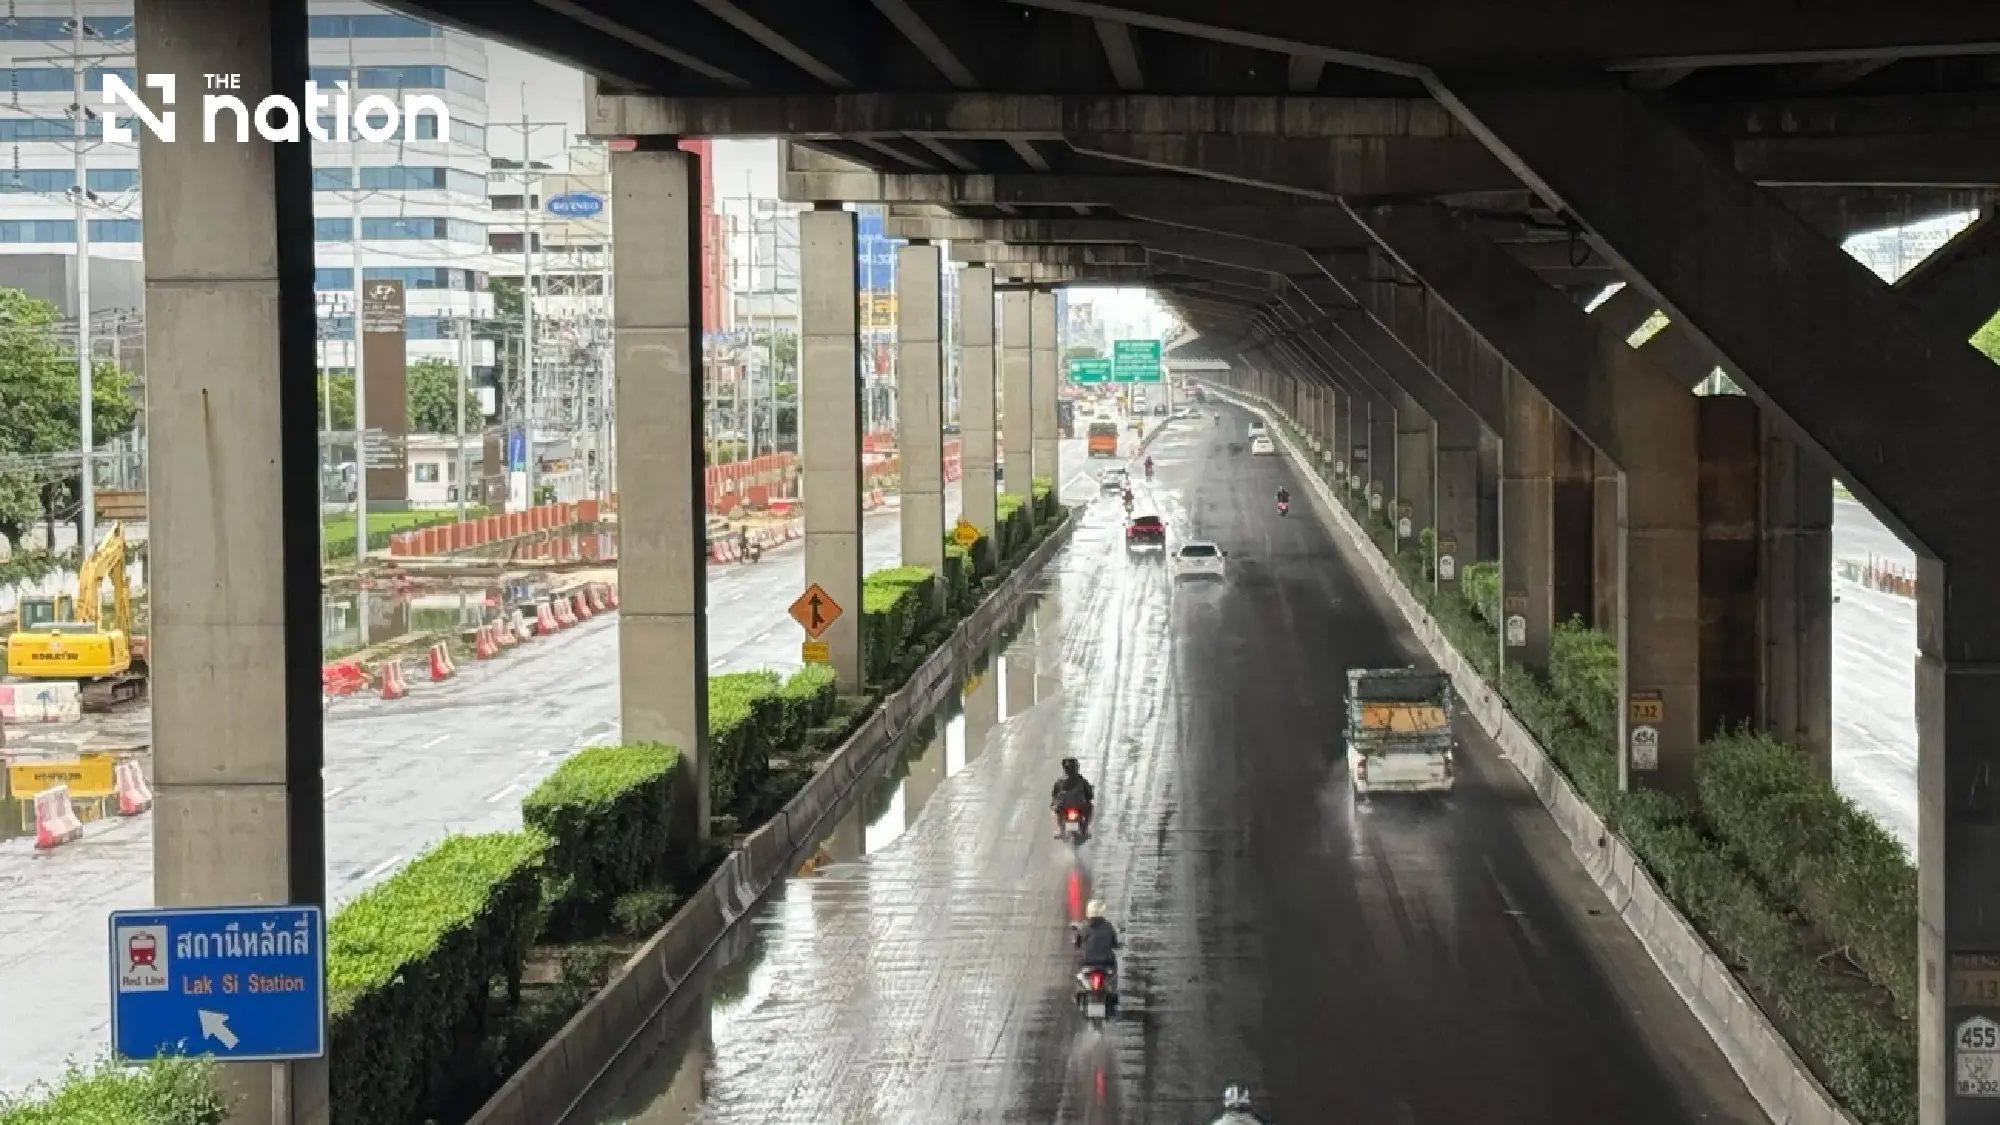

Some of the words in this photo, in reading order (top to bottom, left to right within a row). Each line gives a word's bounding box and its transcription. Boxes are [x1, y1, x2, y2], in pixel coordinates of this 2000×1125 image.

[1634, 731, 1655, 743] 454
[176, 911, 310, 960] สถานีหลักสี่
[122, 976, 142, 987] Red
[145, 976, 166, 986] Line
[182, 975, 213, 995] Lak
[222, 973, 239, 994] Si
[248, 973, 305, 994] Station
[1961, 1027, 1996, 1048] 455
